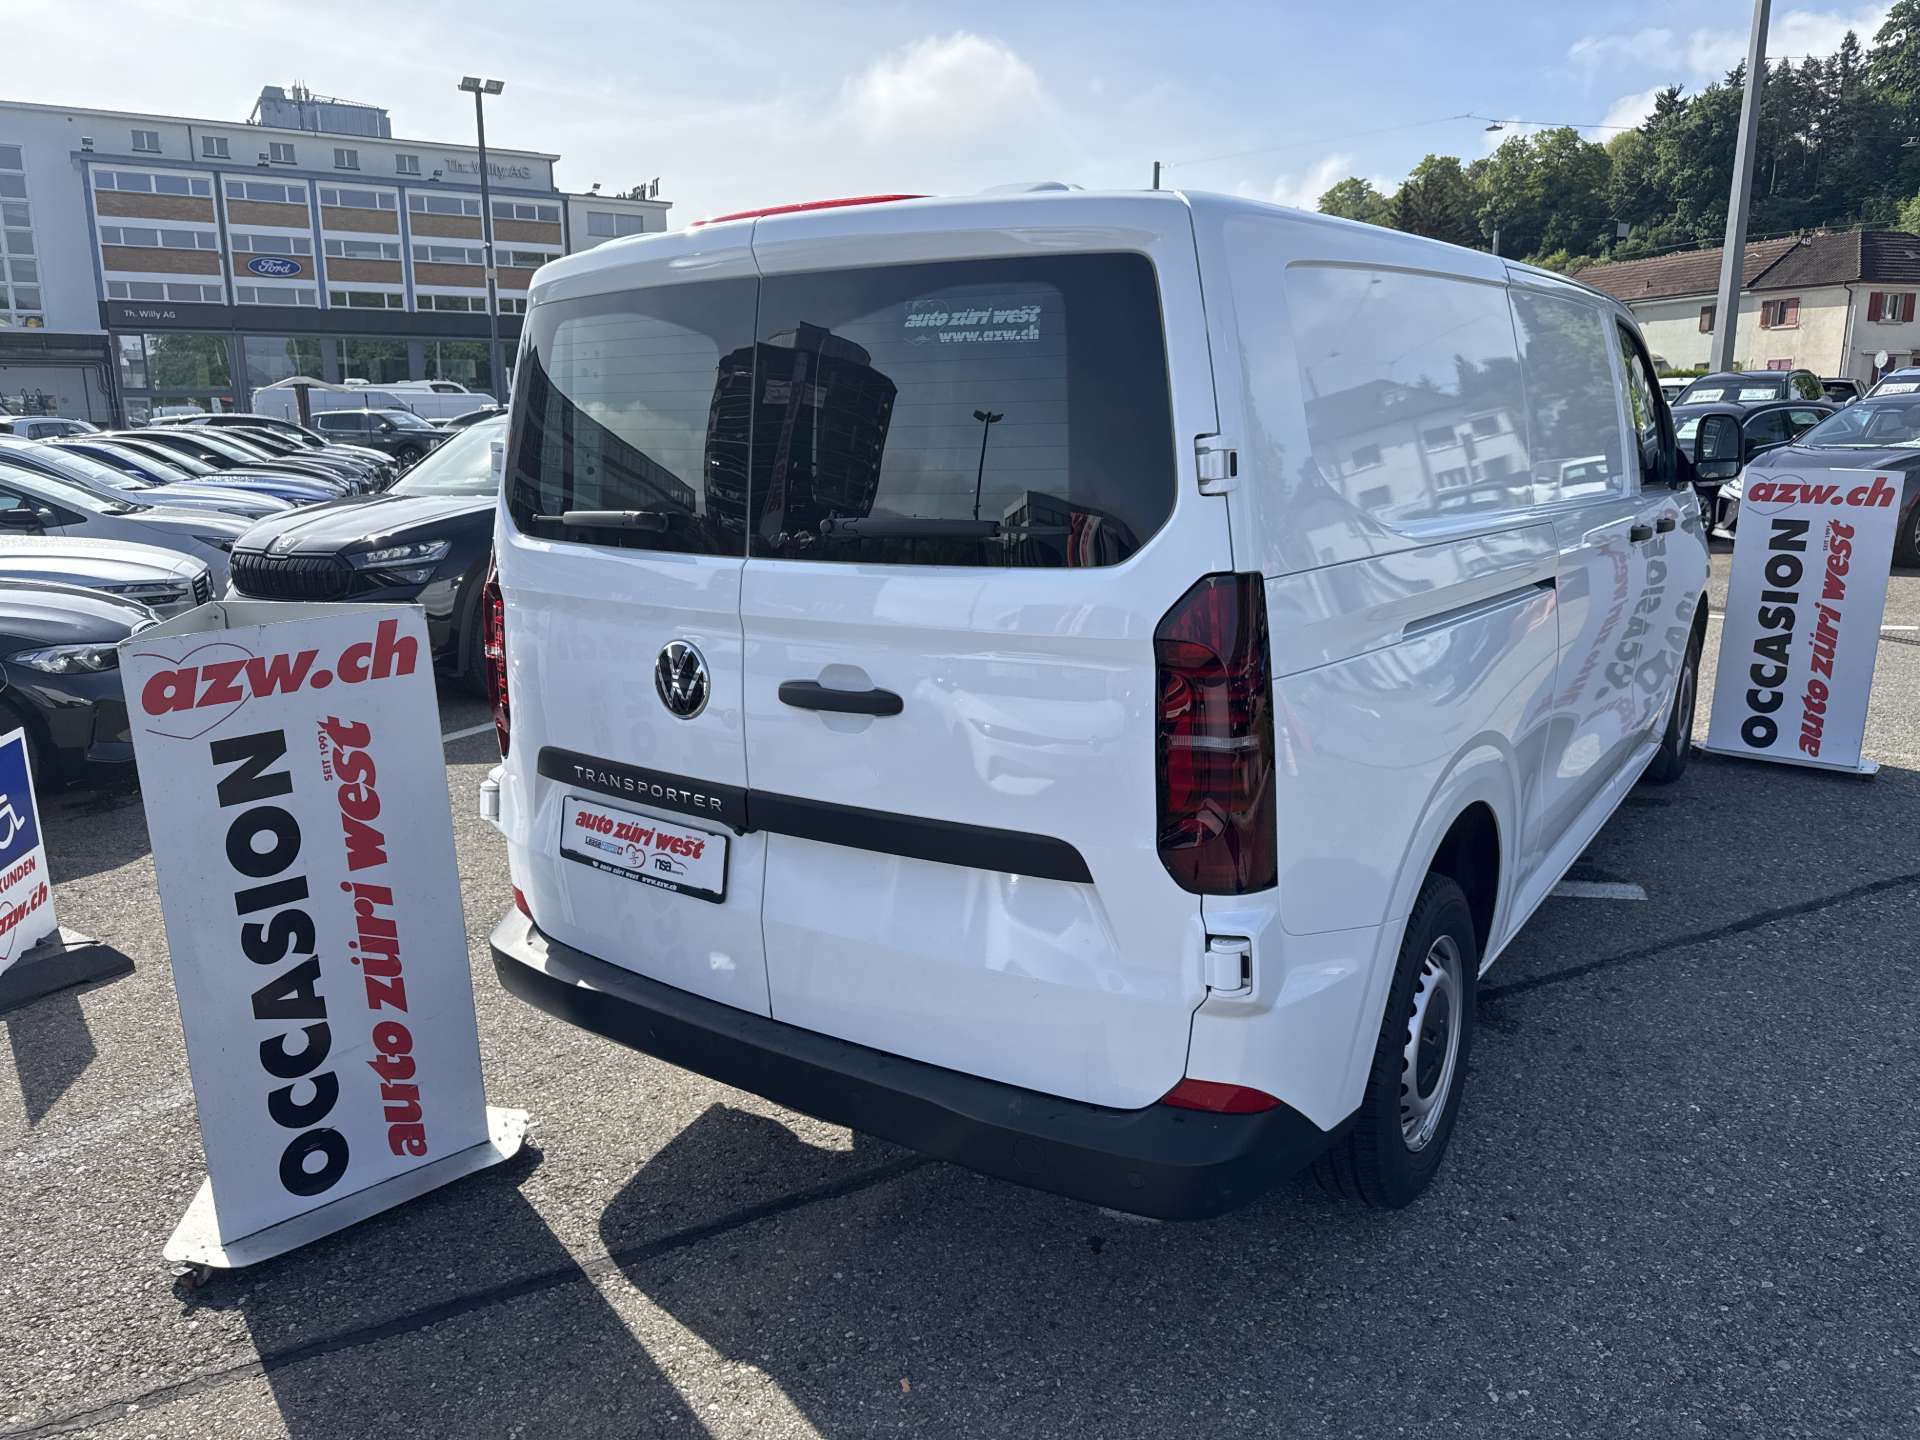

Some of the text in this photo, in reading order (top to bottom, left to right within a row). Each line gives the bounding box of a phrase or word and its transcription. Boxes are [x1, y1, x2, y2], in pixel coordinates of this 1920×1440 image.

[258, 259, 290, 274] Ford
[123, 309, 176, 319] Th. Willy AG
[904, 310, 948, 328] auto
[938, 324, 1039, 342] www.azw.ch
[1748, 477, 1895, 508] azw.ch
[1741, 518, 1810, 748] OCCASION
[1799, 518, 1855, 757] auto züri west
[141, 618, 418, 716] azw.ch
[318, 730, 333, 782] SEIT 1991
[574, 765, 723, 812] TRANSPORTER
[575, 811, 705, 859] auto züri west
[316, 715, 427, 1157] auto züri west
[210, 728, 349, 1197] OCCASION
